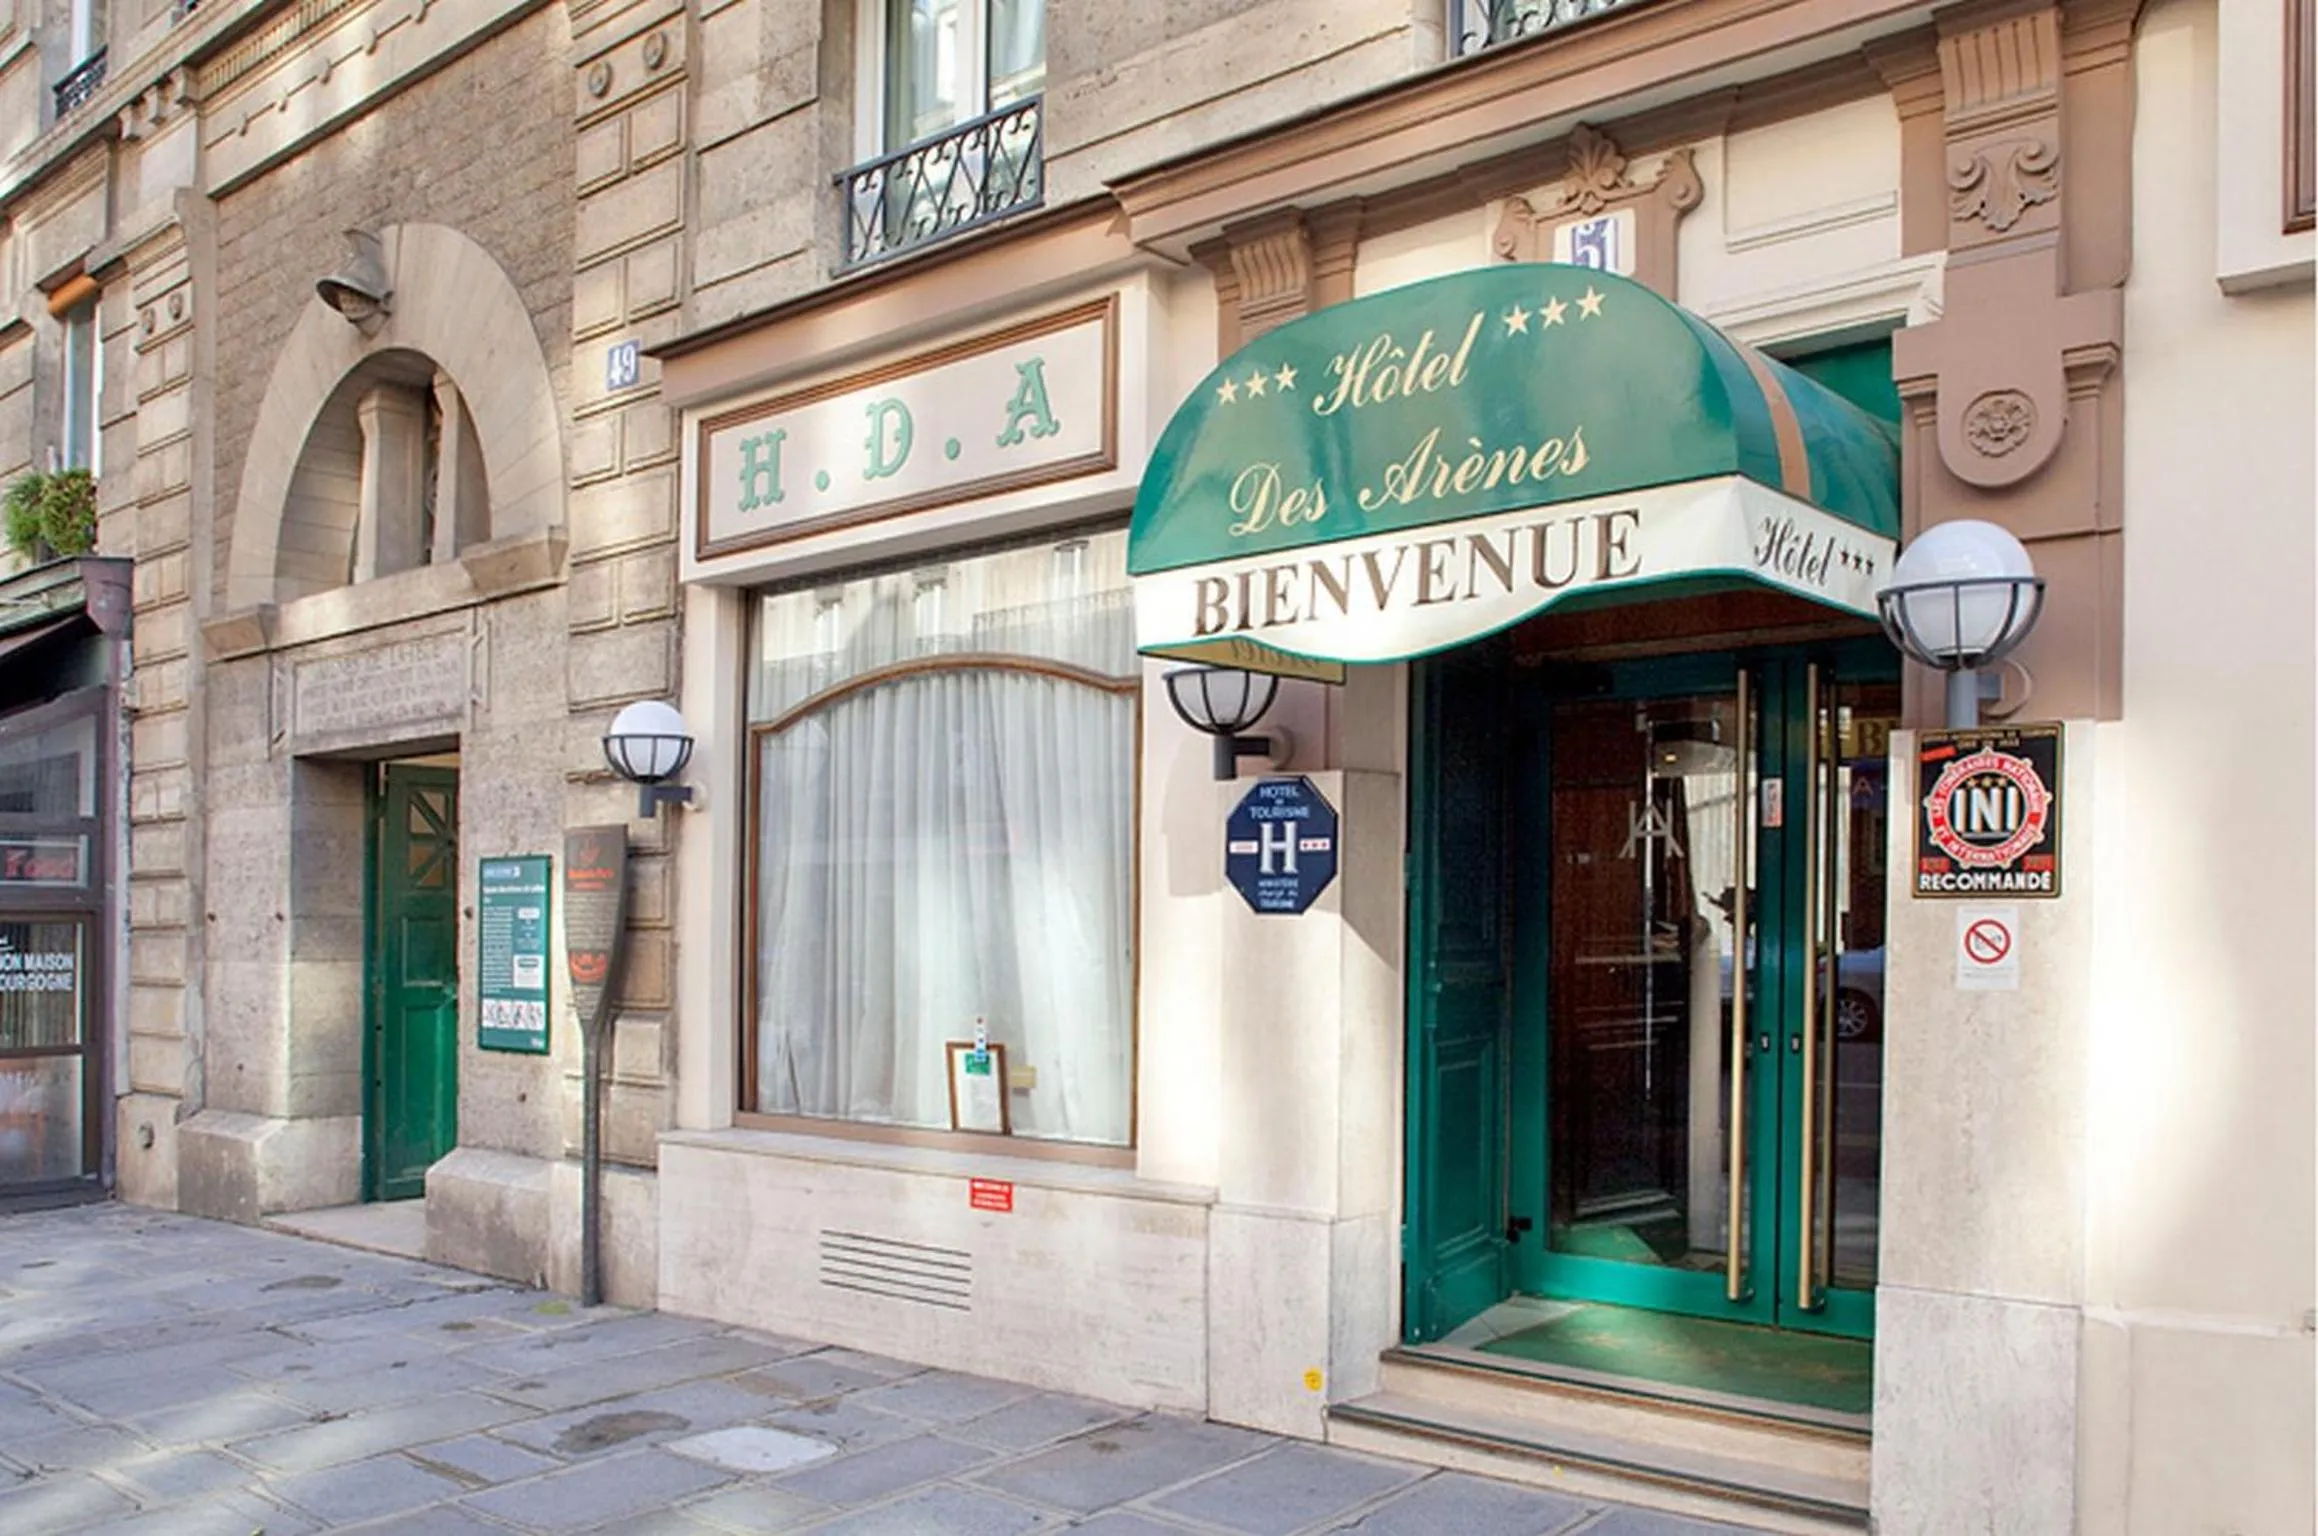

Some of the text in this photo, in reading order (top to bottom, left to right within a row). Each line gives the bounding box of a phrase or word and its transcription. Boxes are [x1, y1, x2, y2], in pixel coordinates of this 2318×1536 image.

[1575, 218, 1616, 271] 51
[610, 345, 636, 385] 49
[1312, 312, 1486, 416] Hôtel
[1229, 425, 1592, 537] Des Arènes
[1192, 508, 1643, 637] BIENVENUE
[1754, 516, 1835, 586] Hôtel
[1260, 785, 1300, 799] HOTEL
[1954, 786, 2020, 832] INI
[1260, 821, 1299, 876] H
[24, 953, 73, 970] MAISON
